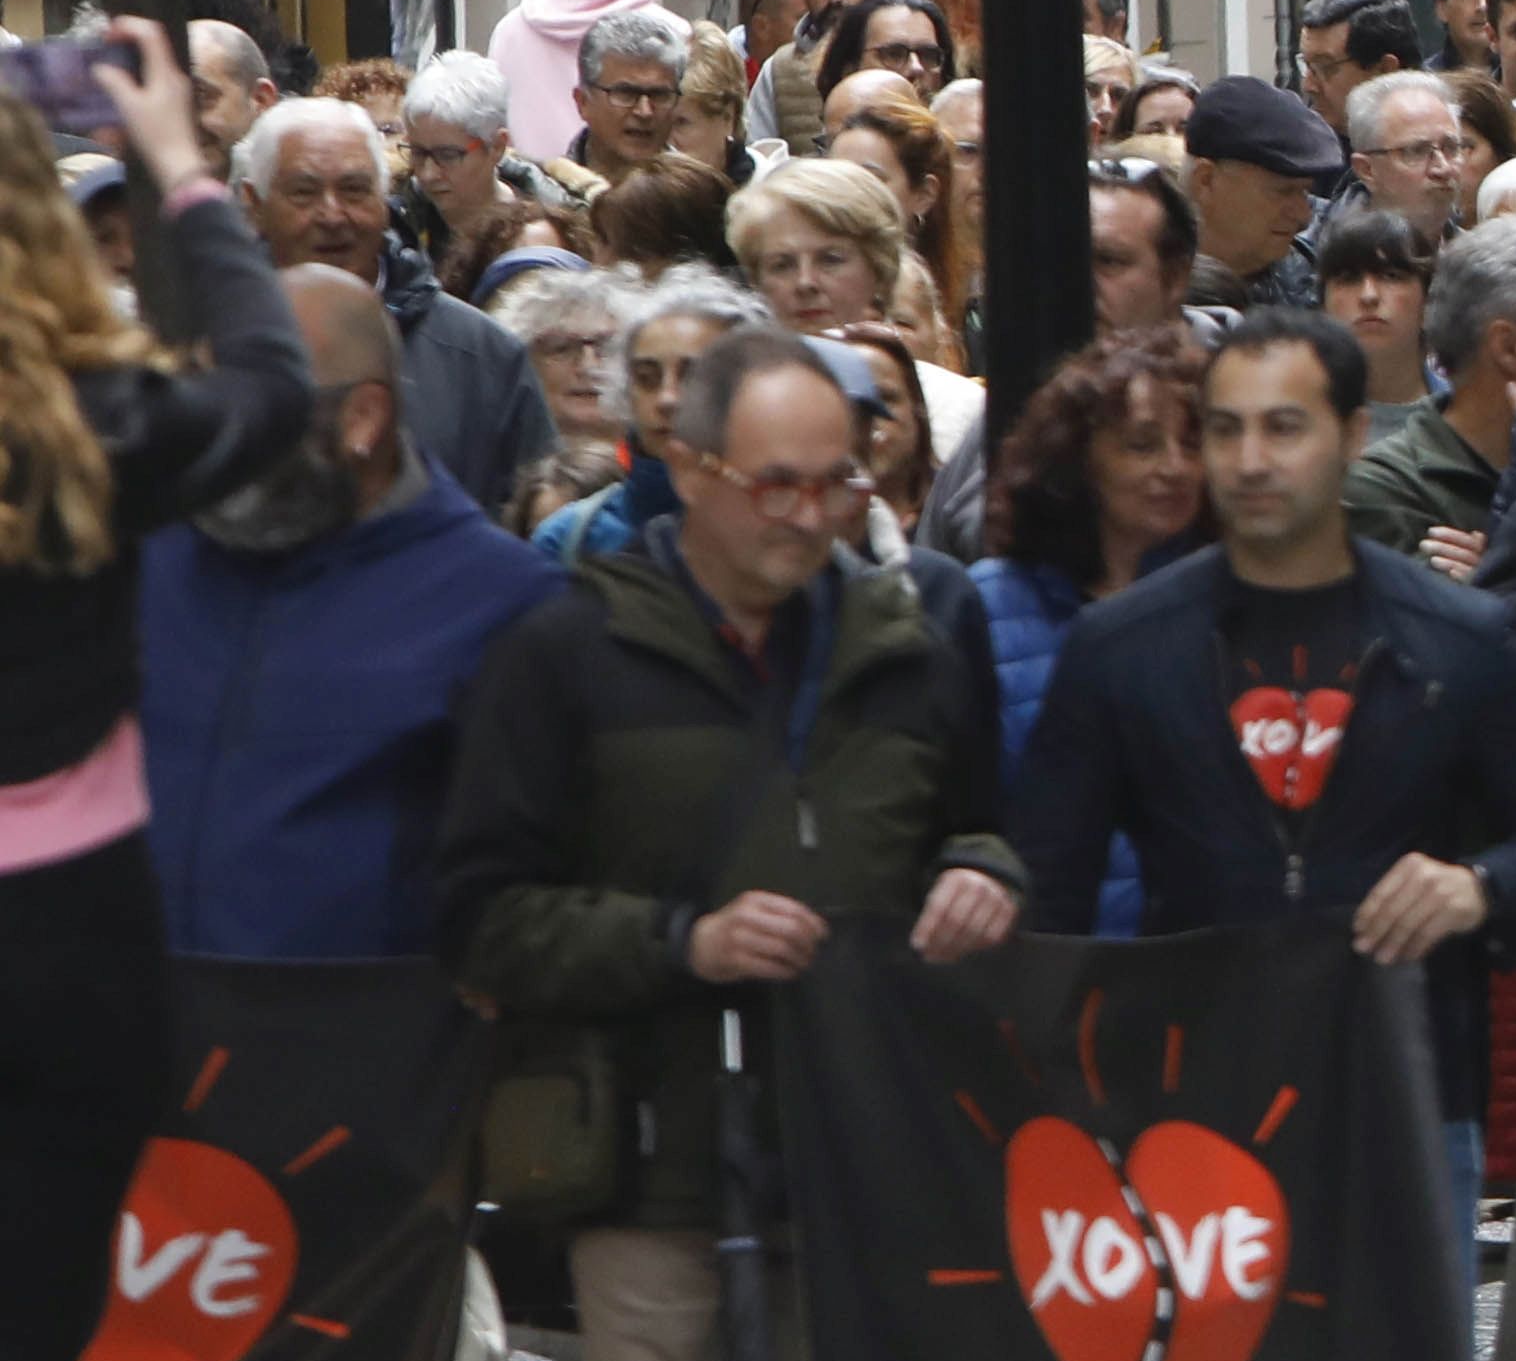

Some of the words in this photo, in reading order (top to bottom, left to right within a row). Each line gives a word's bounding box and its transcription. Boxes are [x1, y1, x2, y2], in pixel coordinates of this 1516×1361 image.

[1239, 719, 1342, 758] XOV
[118, 1212, 271, 1317] VE
[1030, 1205, 1273, 1308] XOVE
